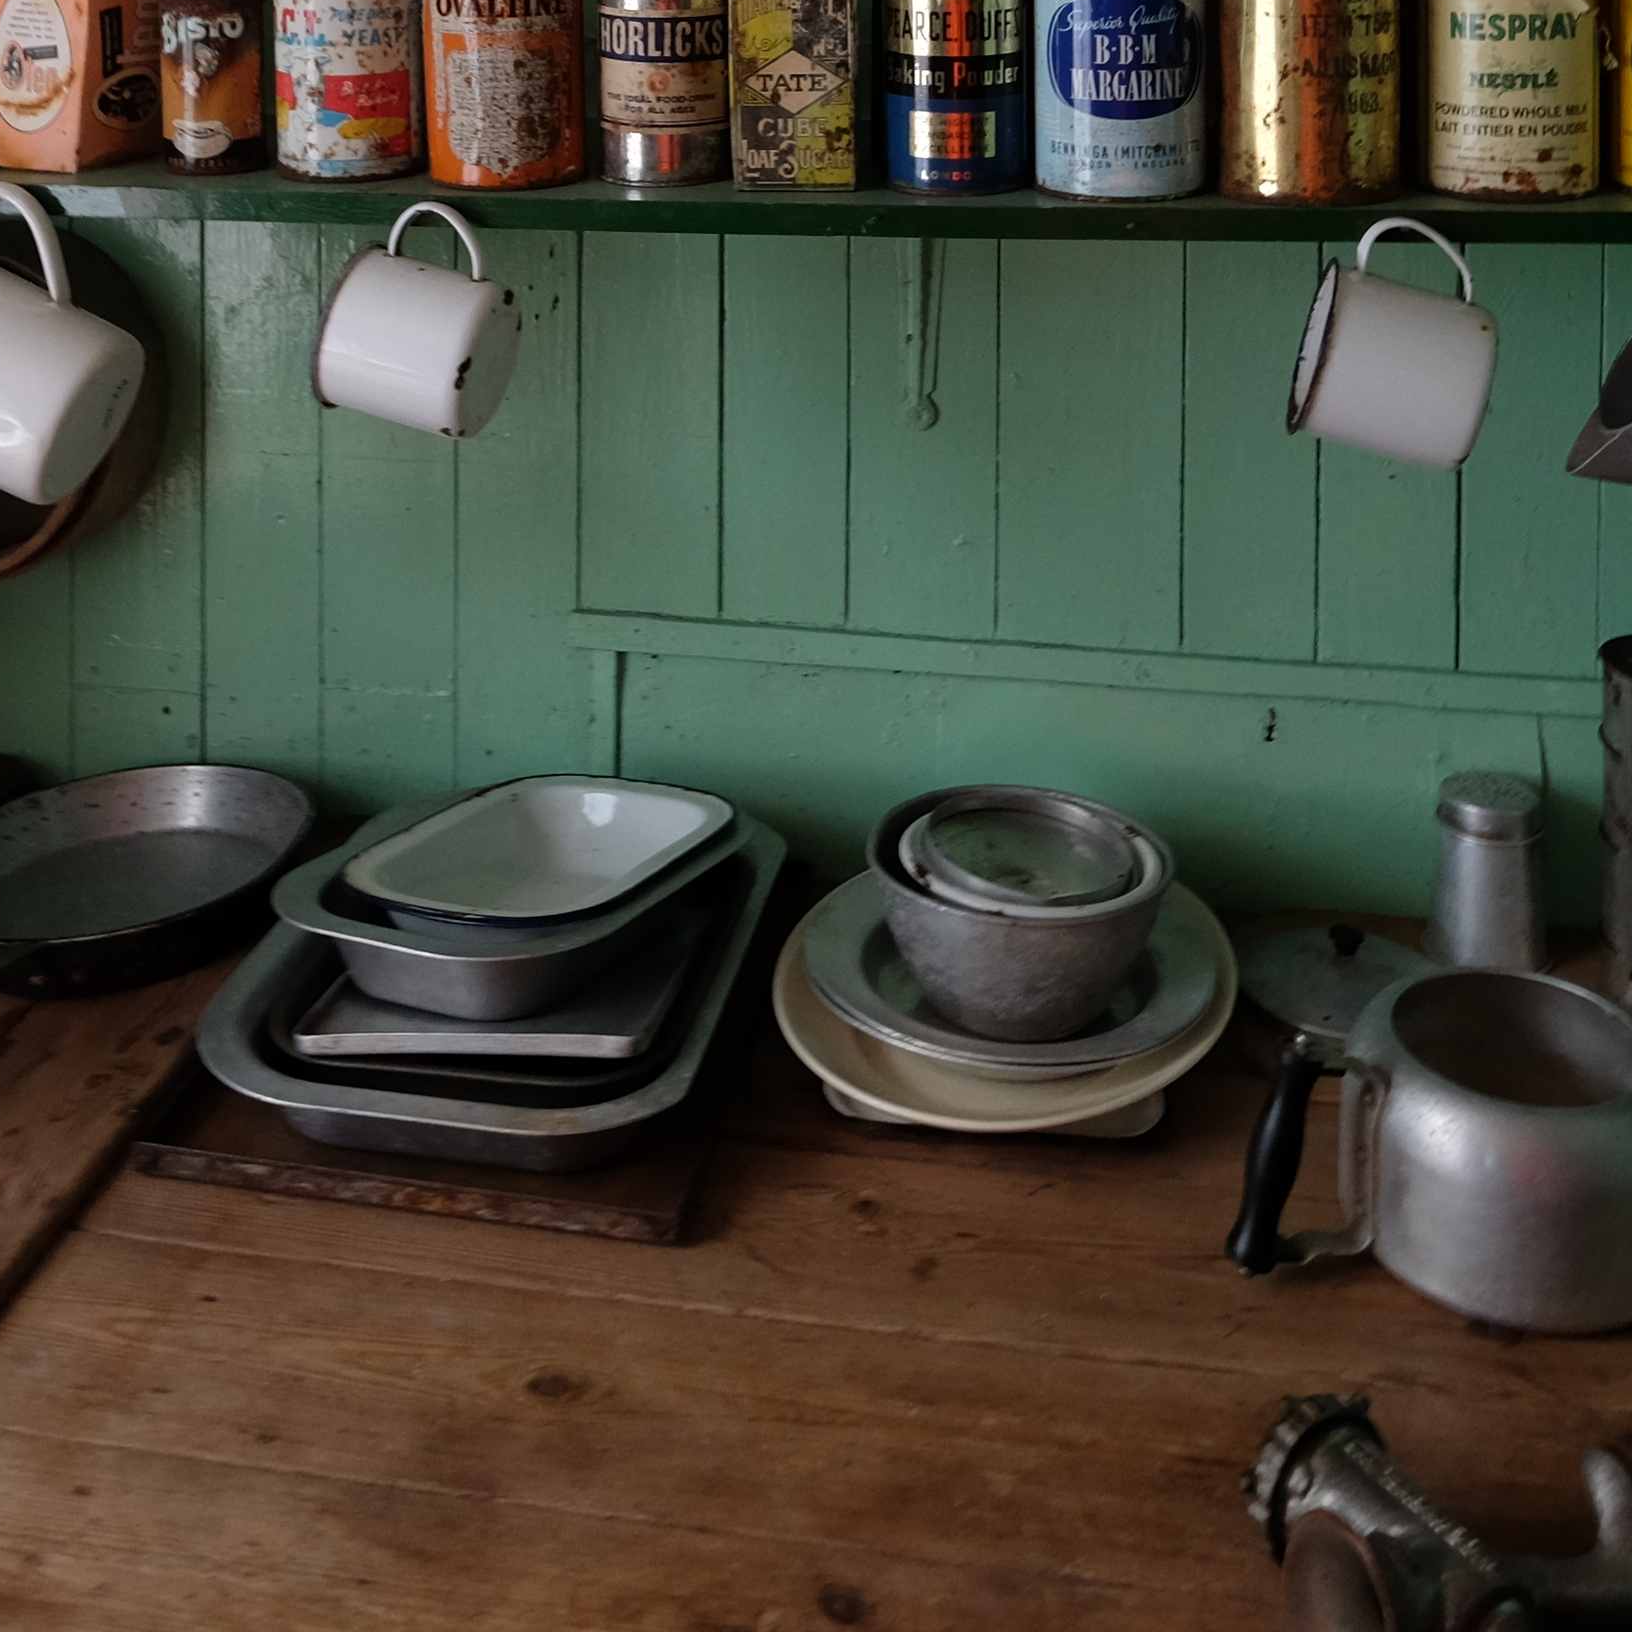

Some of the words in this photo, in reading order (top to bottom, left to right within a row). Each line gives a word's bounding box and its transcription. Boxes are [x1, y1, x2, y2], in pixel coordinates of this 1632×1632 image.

[1058, 8, 1126, 40] Superior
[1128, 4, 1180, 35] Quality
[1450, 11, 1581, 42] NESPRAY
[342, 28, 405, 47] YEAST
[600, 16, 723, 57] HORLICKS
[756, 73, 828, 92] TATE
[887, 55, 946, 94] Baking
[952, 59, 1020, 88] Powder
[1070, 67, 1185, 102] MARGARINE
[624, 94, 652, 104] IDEAL
[624, 104, 643, 113] FOR
[647, 106, 665, 114] ALL
[670, 105, 697, 114] AGES
[1435, 101, 1510, 119] POWDERED
[1512, 104, 1562, 119] WHOLE
[757, 117, 828, 138] CUBE
[1435, 121, 1458, 135] LAIT
[1463, 124, 1514, 138] ENTIER
[1518, 124, 1538, 137] EN
[1541, 119, 1589, 137] POUDRE
[739, 138, 779, 169] LOAF
[778, 139, 850, 179] SUGAR
